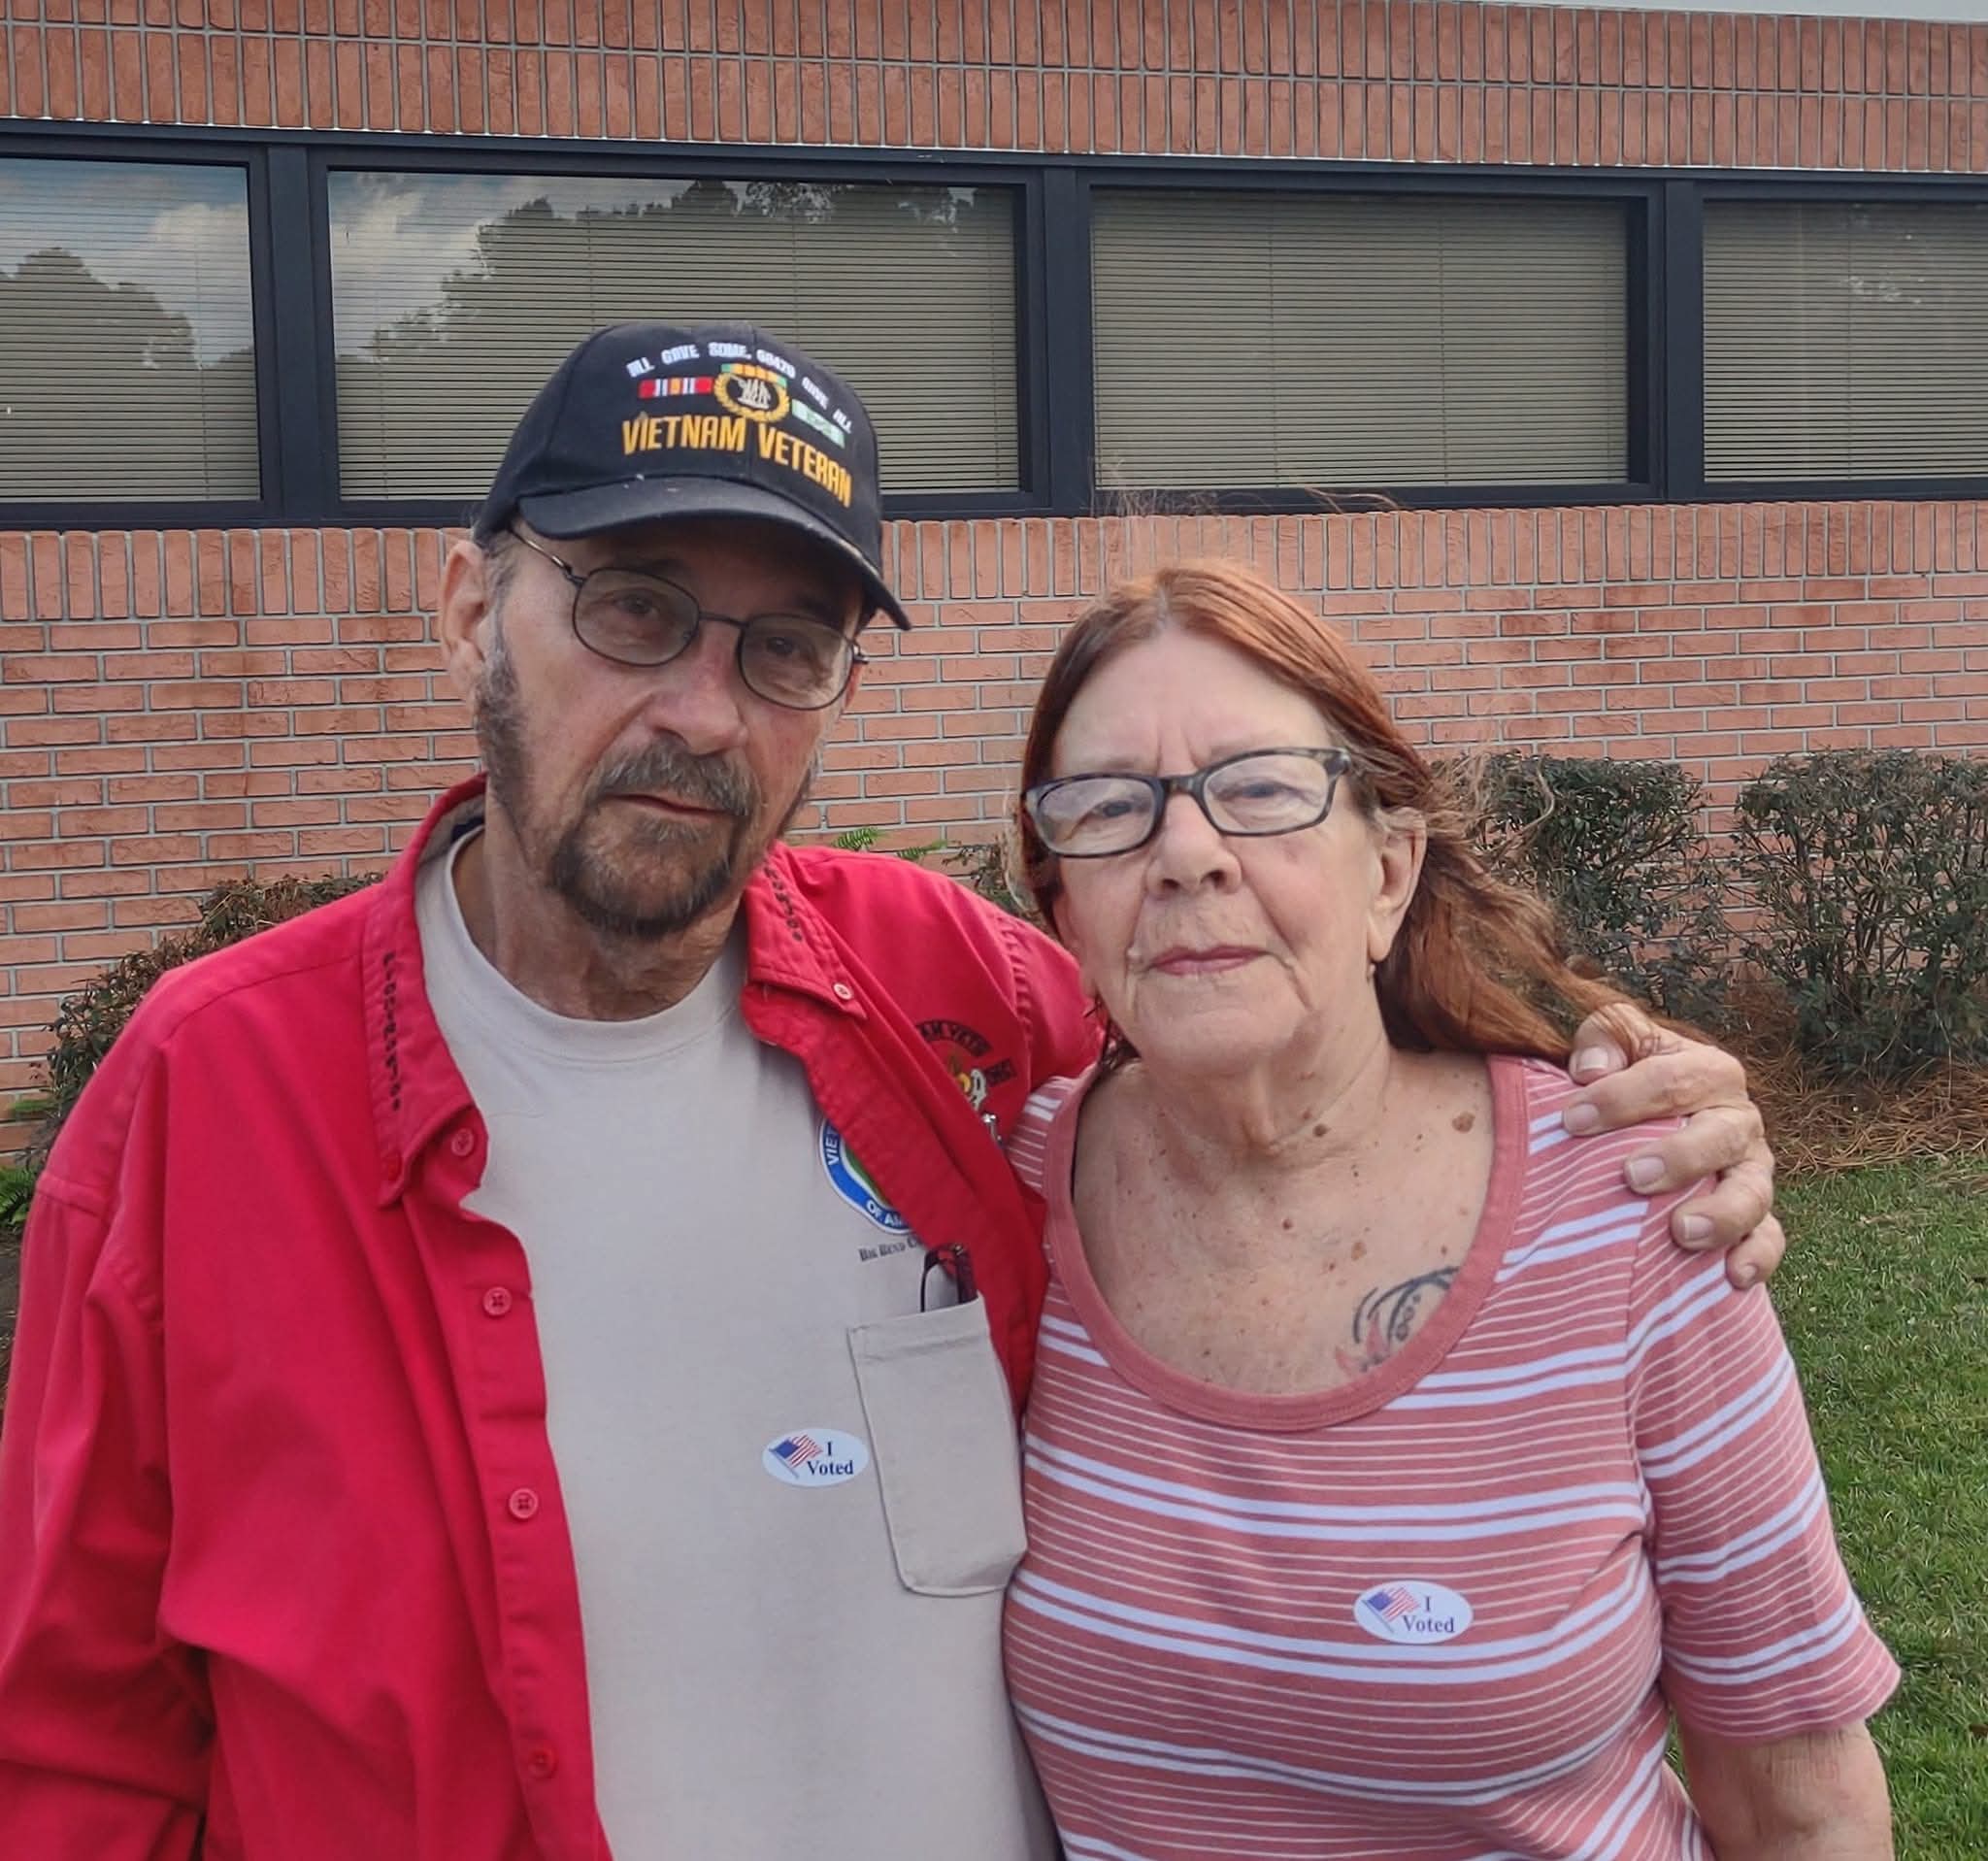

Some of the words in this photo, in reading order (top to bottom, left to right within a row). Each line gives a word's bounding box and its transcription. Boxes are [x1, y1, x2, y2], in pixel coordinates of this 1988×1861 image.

[622, 415, 747, 455] VIETNAM
[756, 423, 852, 508] VETERAN
[826, 1441, 834, 1457] I
[807, 1459, 854, 1476] Voted
[1423, 1595, 1433, 1612] I
[1402, 1614, 1455, 1633] Voted
